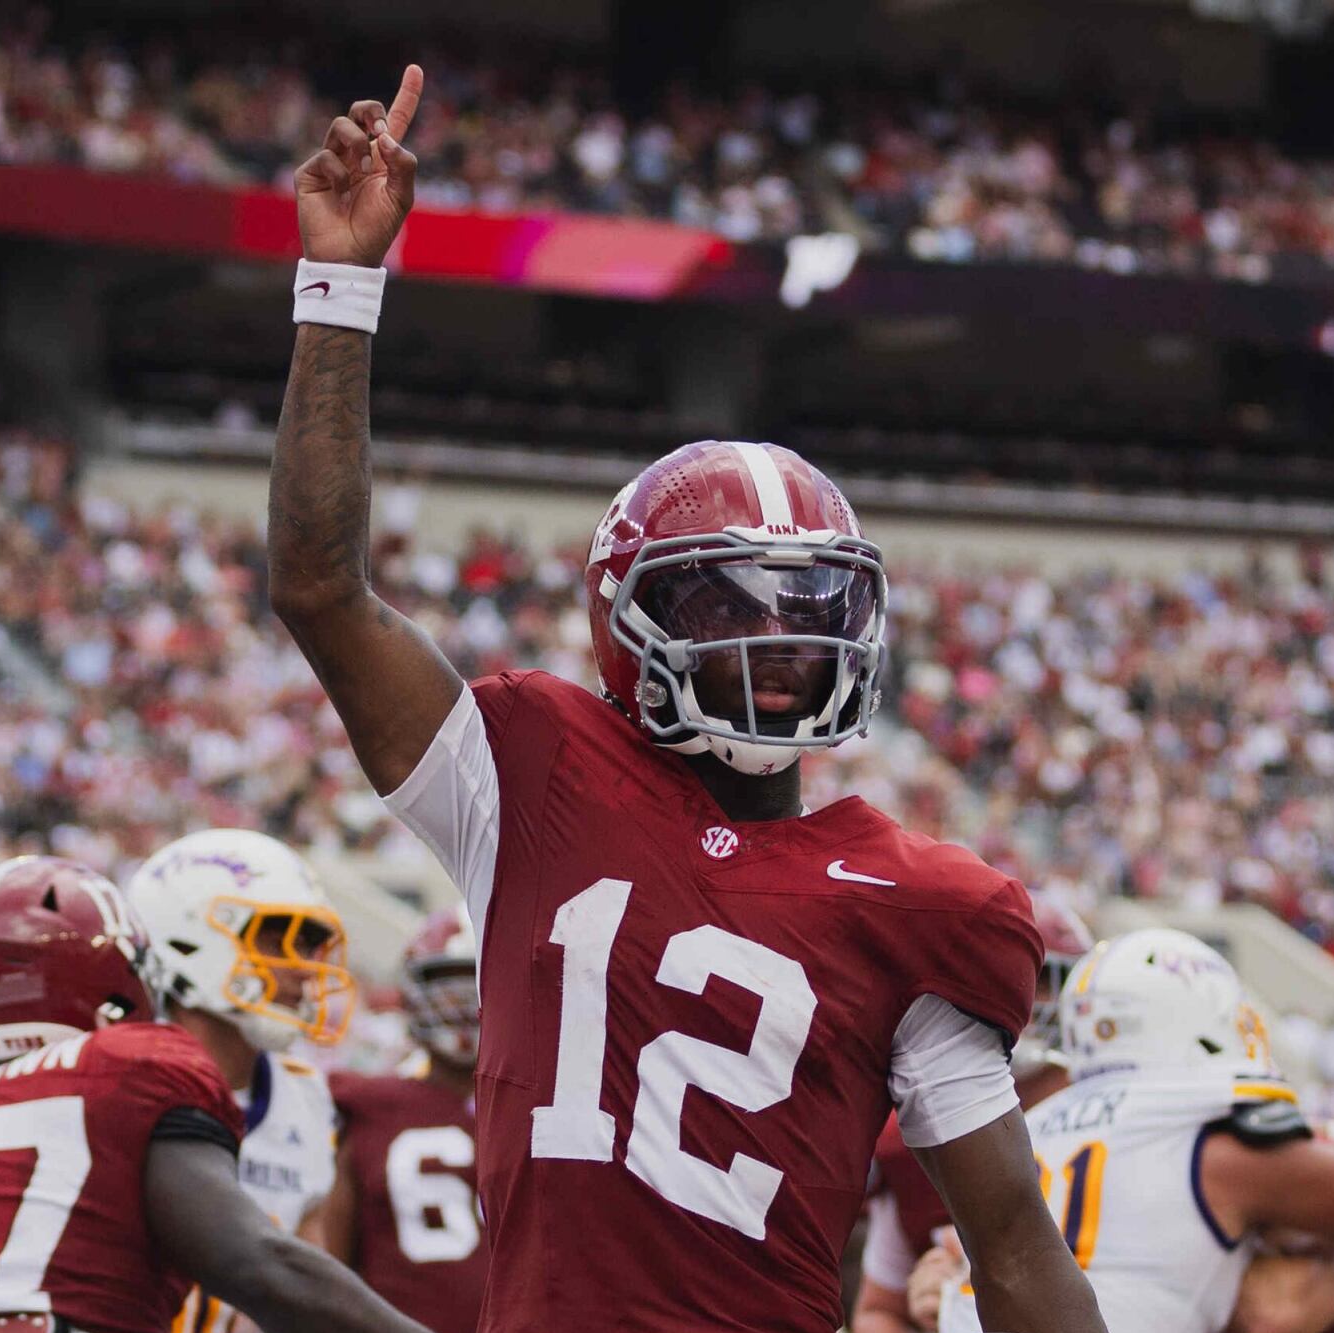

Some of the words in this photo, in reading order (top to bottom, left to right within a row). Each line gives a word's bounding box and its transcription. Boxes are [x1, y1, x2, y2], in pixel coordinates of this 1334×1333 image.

[767, 524, 799, 536] BAMA
[701, 826, 739, 858] SEC
[531, 877, 818, 1241] 12
[386, 1126, 481, 1264] 6
